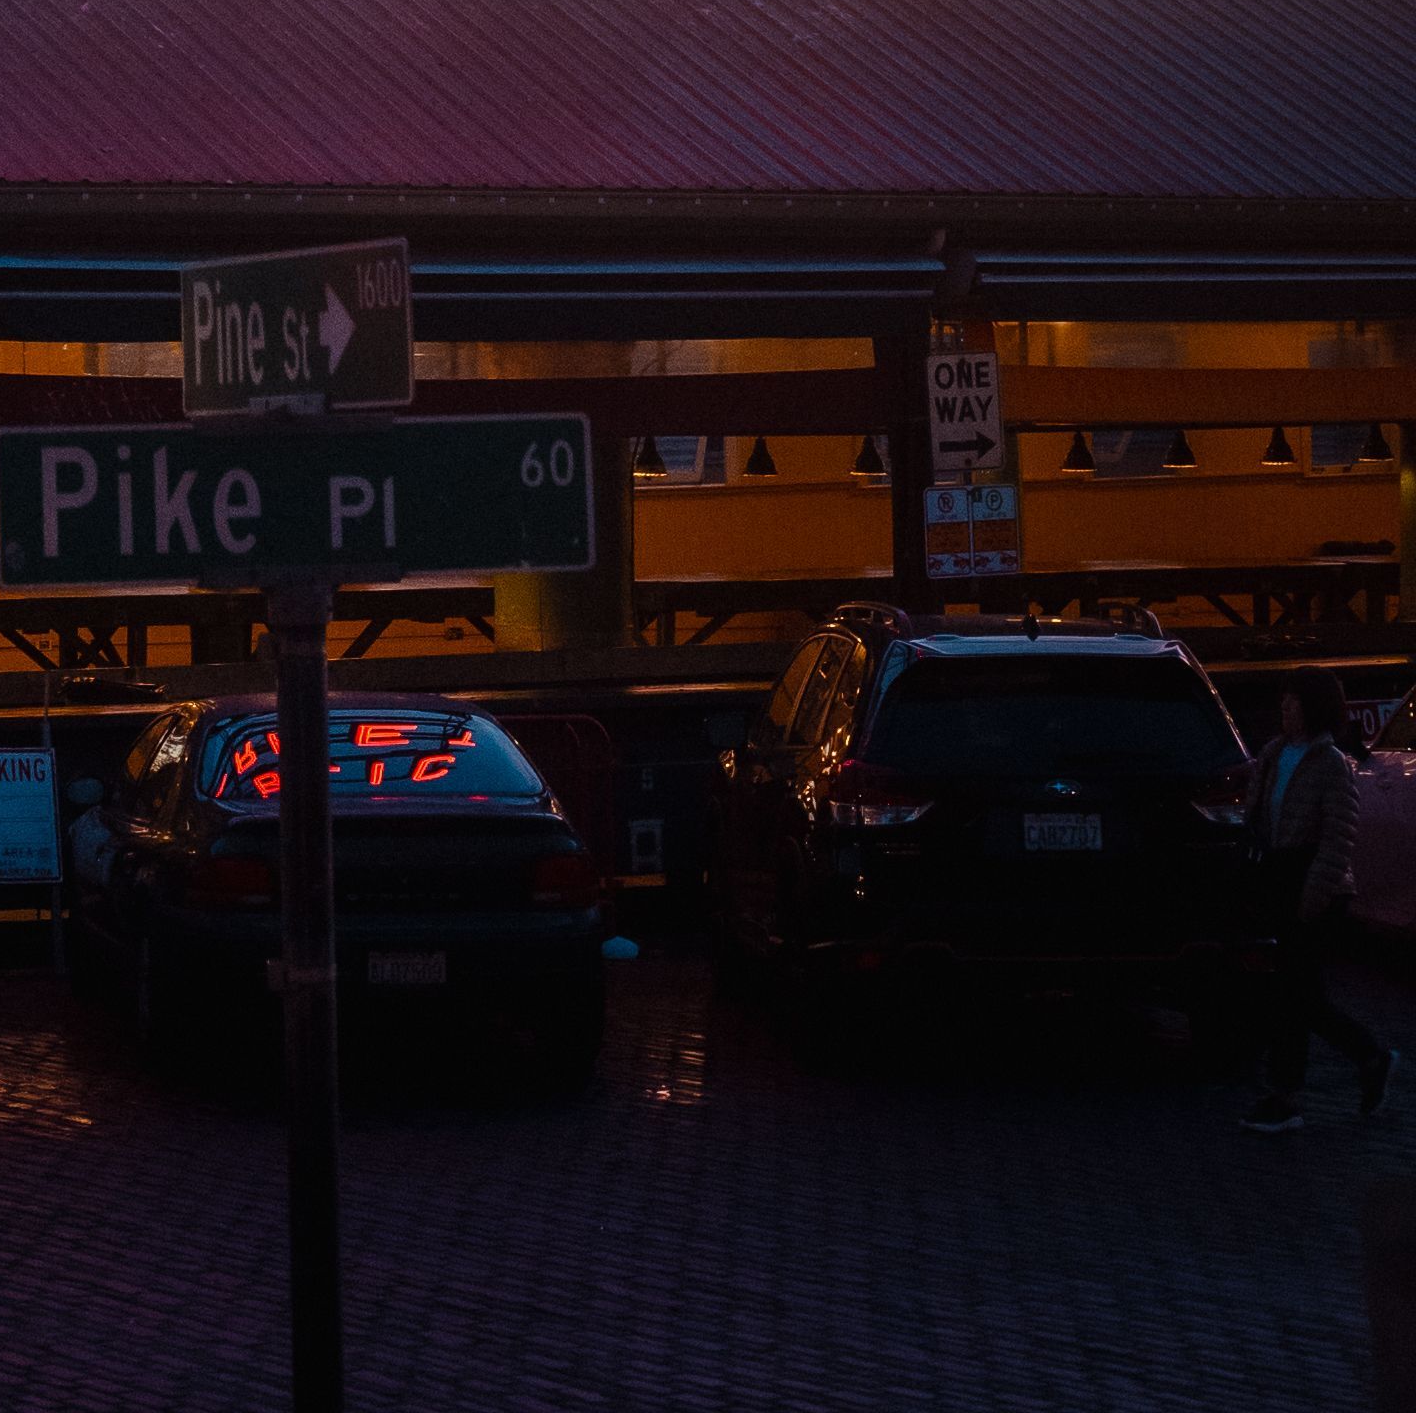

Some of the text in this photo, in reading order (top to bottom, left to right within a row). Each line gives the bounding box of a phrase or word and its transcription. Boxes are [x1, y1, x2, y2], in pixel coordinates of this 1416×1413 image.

[357, 259, 402, 309] 1600
[192, 279, 265, 385] Pine
[935, 360, 991, 389] ONE
[935, 395, 993, 423] WAY
[520, 438, 575, 488] 60
[40, 445, 397, 559] Pike Pl
